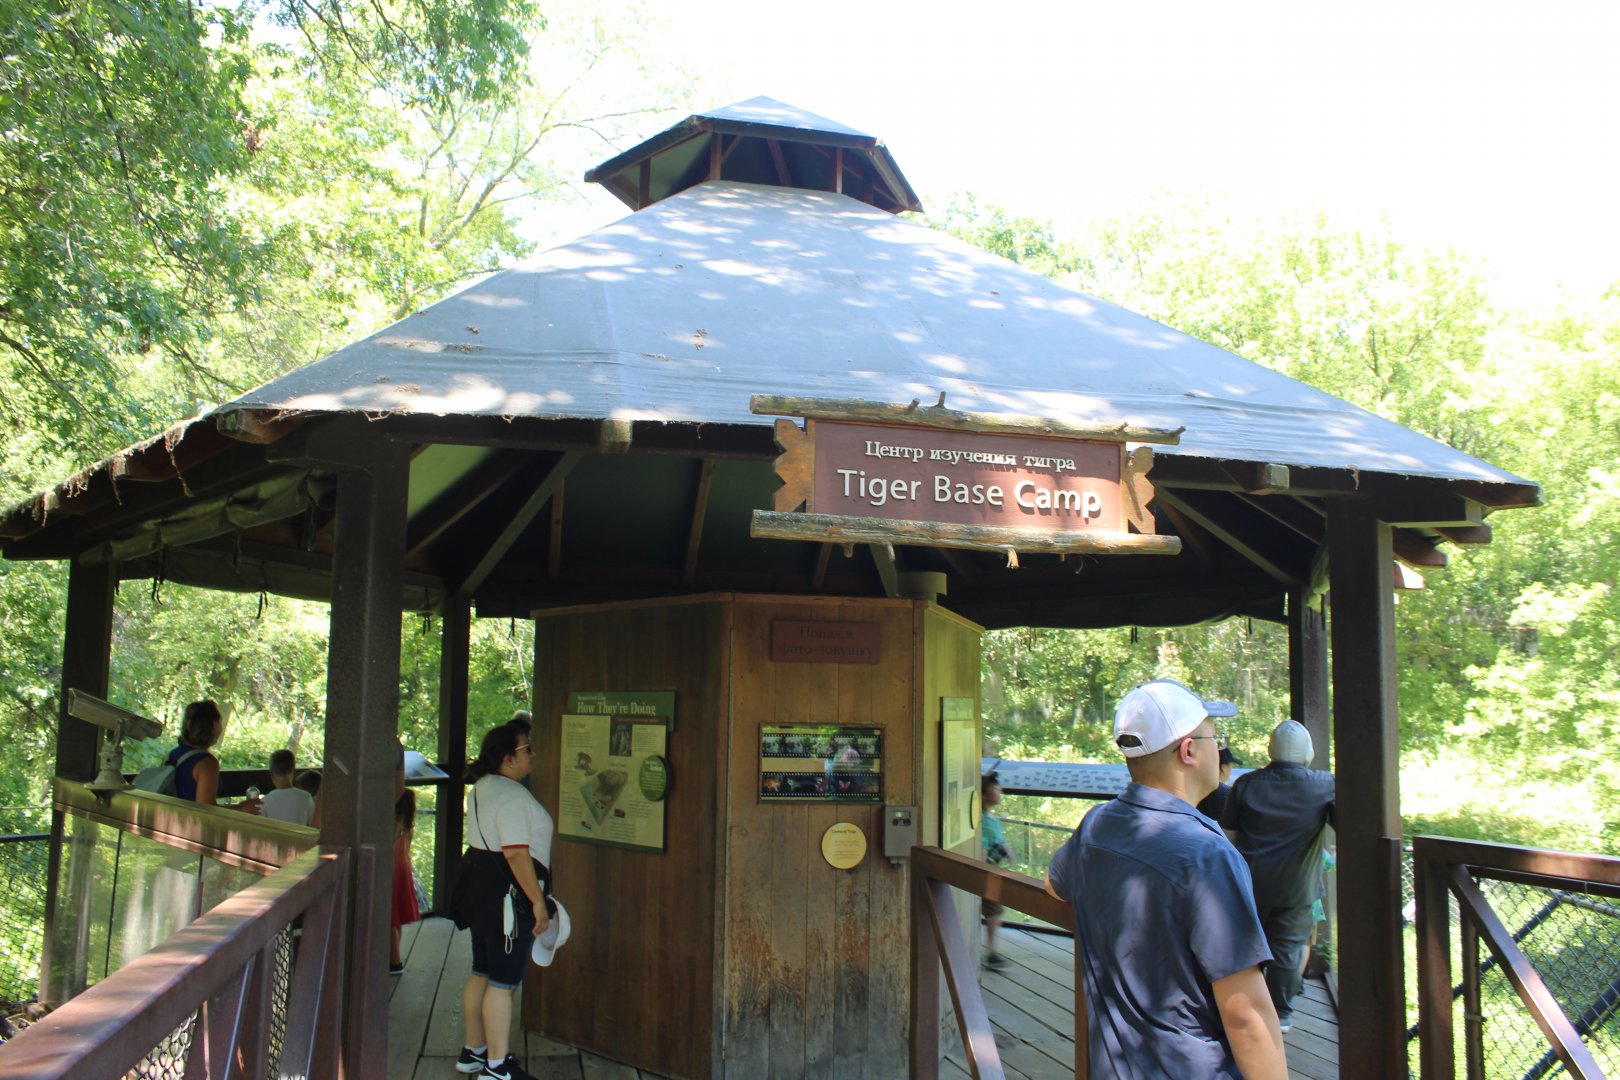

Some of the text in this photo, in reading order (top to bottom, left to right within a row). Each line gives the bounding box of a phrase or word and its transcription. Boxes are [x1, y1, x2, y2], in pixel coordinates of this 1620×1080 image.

[865, 441, 1076, 472] Центр изучения тигра
[837, 469, 1101, 518] Tiger Base Camp
[577, 701, 656, 716] How They're Doing
